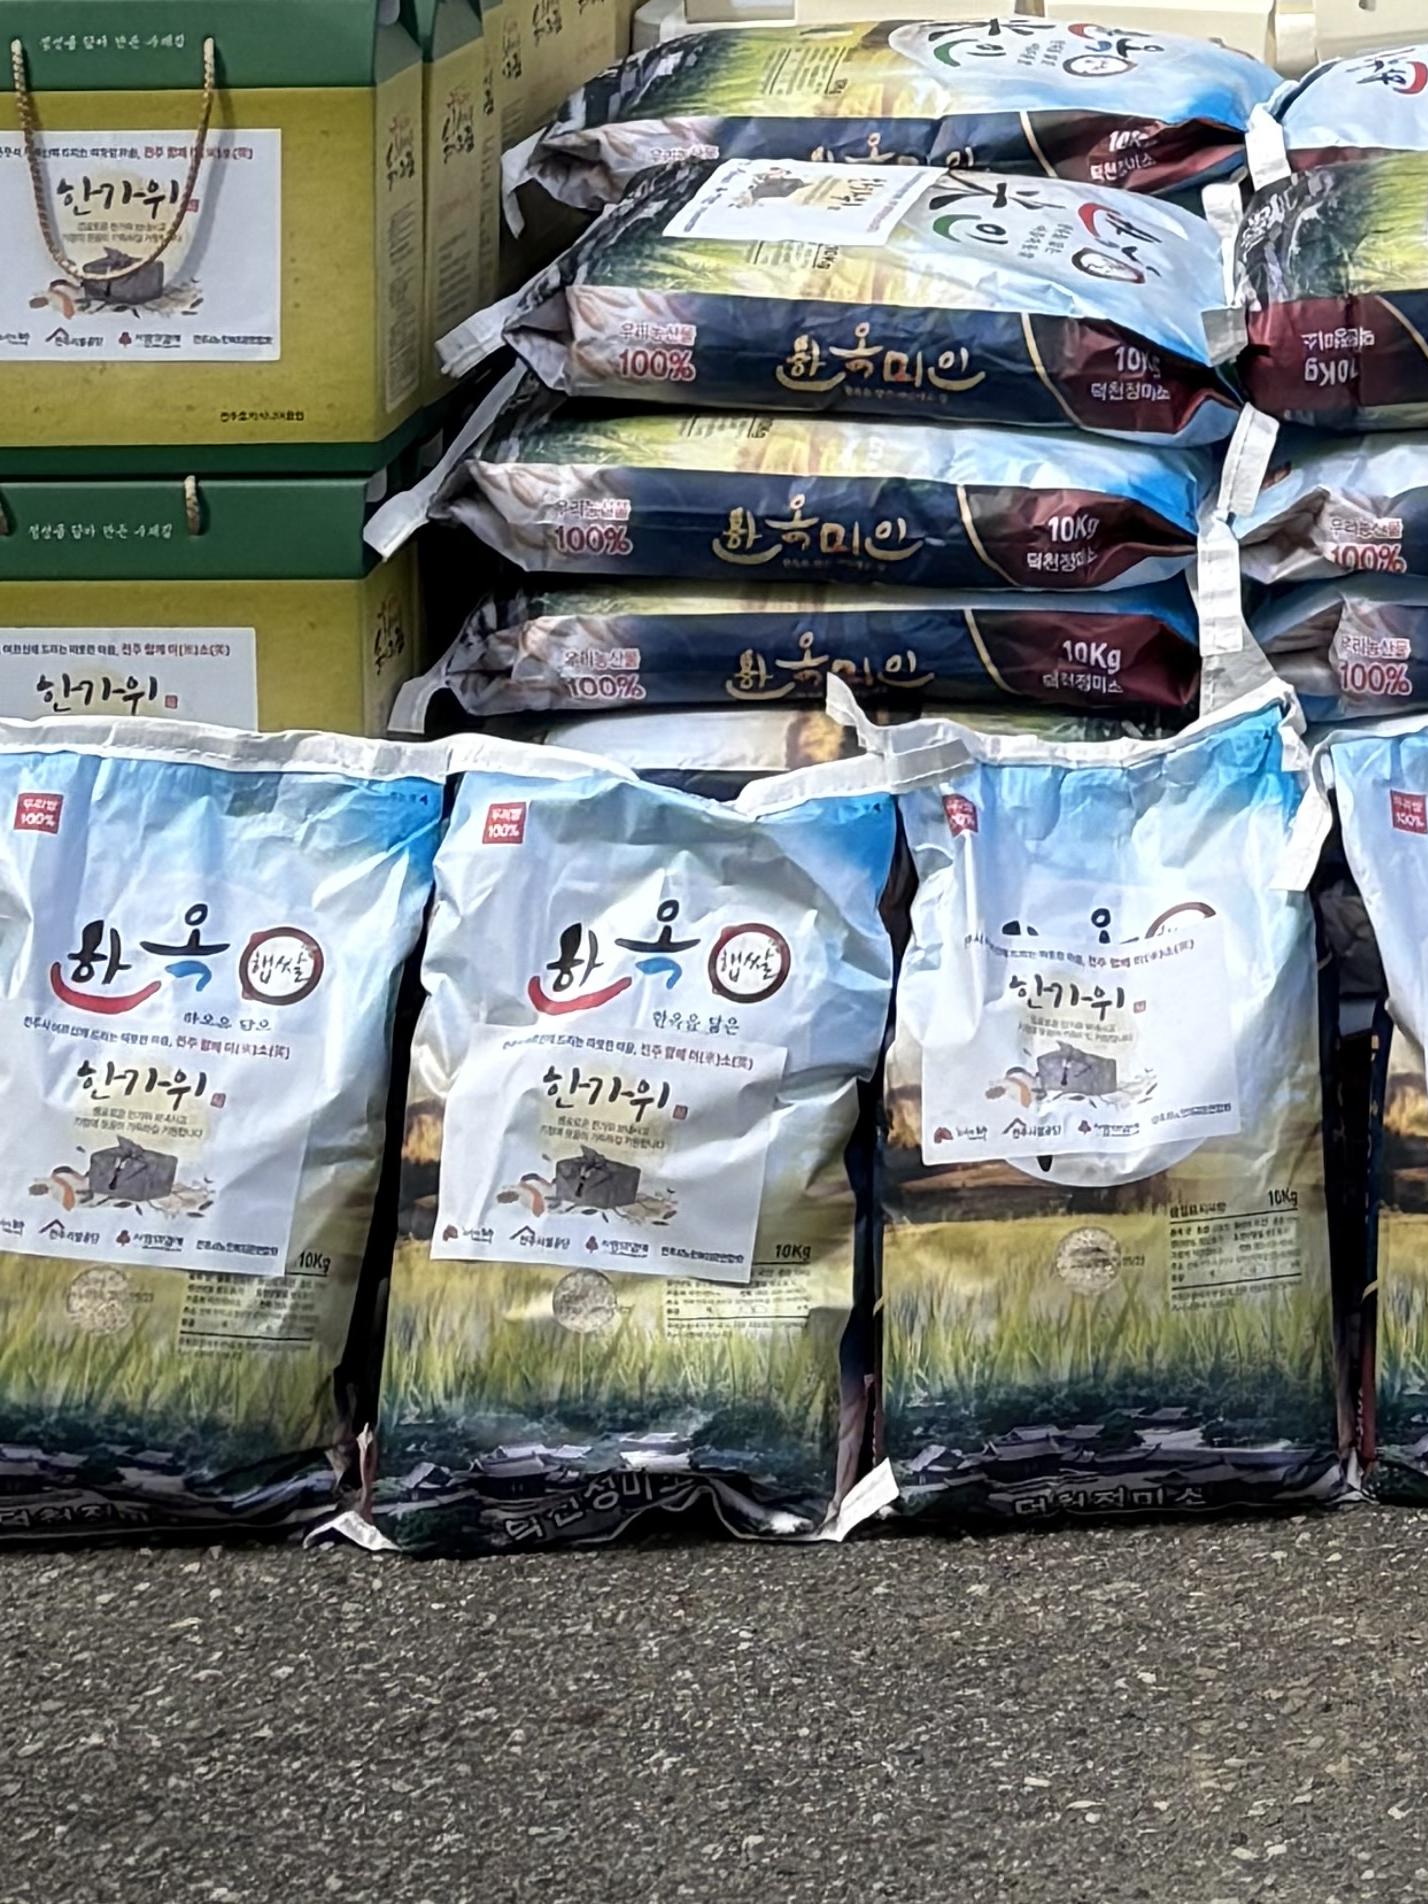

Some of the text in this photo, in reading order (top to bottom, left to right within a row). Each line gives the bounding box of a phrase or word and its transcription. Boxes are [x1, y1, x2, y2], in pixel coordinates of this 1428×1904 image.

[56, 175, 181, 217] 한가위
[616, 348, 697, 383] 100%
[776, 321, 985, 392] 한옥미인
[552, 524, 633, 556] 100%
[711, 493, 924, 566] 한옥미인
[1047, 513, 1099, 544] 10Kg
[1330, 543, 1408, 574] 100%
[1060, 638, 1122, 672] 10Kg
[37, 674, 158, 716] 한가위
[566, 673, 646, 701] 100%
[1337, 663, 1412, 696] 100%
[20, 812, 56, 829] 100%
[487, 822, 522, 839] 100%
[1009, 974, 1125, 1021] 한가위
[77, 1059, 207, 1113] 한가위
[543, 1066, 670, 1125] 한가위
[299, 1251, 332, 1271] 10Kg
[775, 1244, 812, 1260] 10Kg
